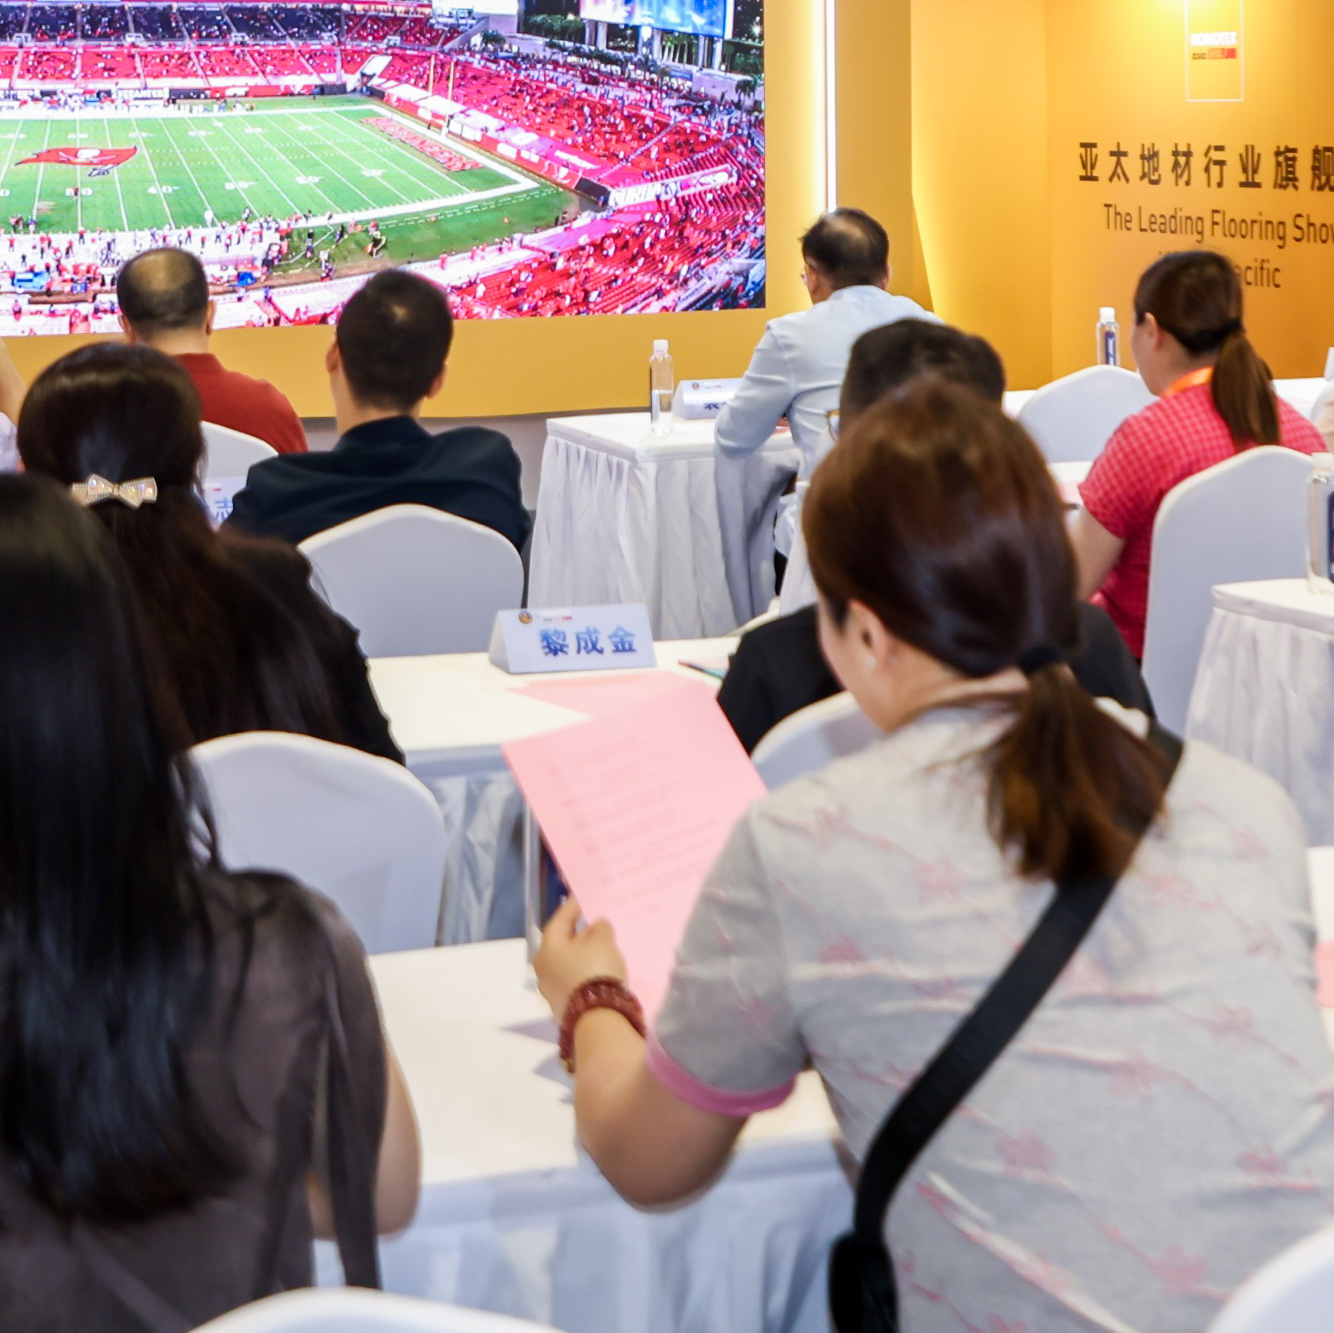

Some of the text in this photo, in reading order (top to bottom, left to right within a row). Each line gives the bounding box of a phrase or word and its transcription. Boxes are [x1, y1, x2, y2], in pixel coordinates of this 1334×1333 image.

[1103, 204, 1133, 232] The
[1138, 206, 1205, 243] Leading
[1211, 209, 1287, 249] Flooring
[539, 624, 637, 657] 黎成金
